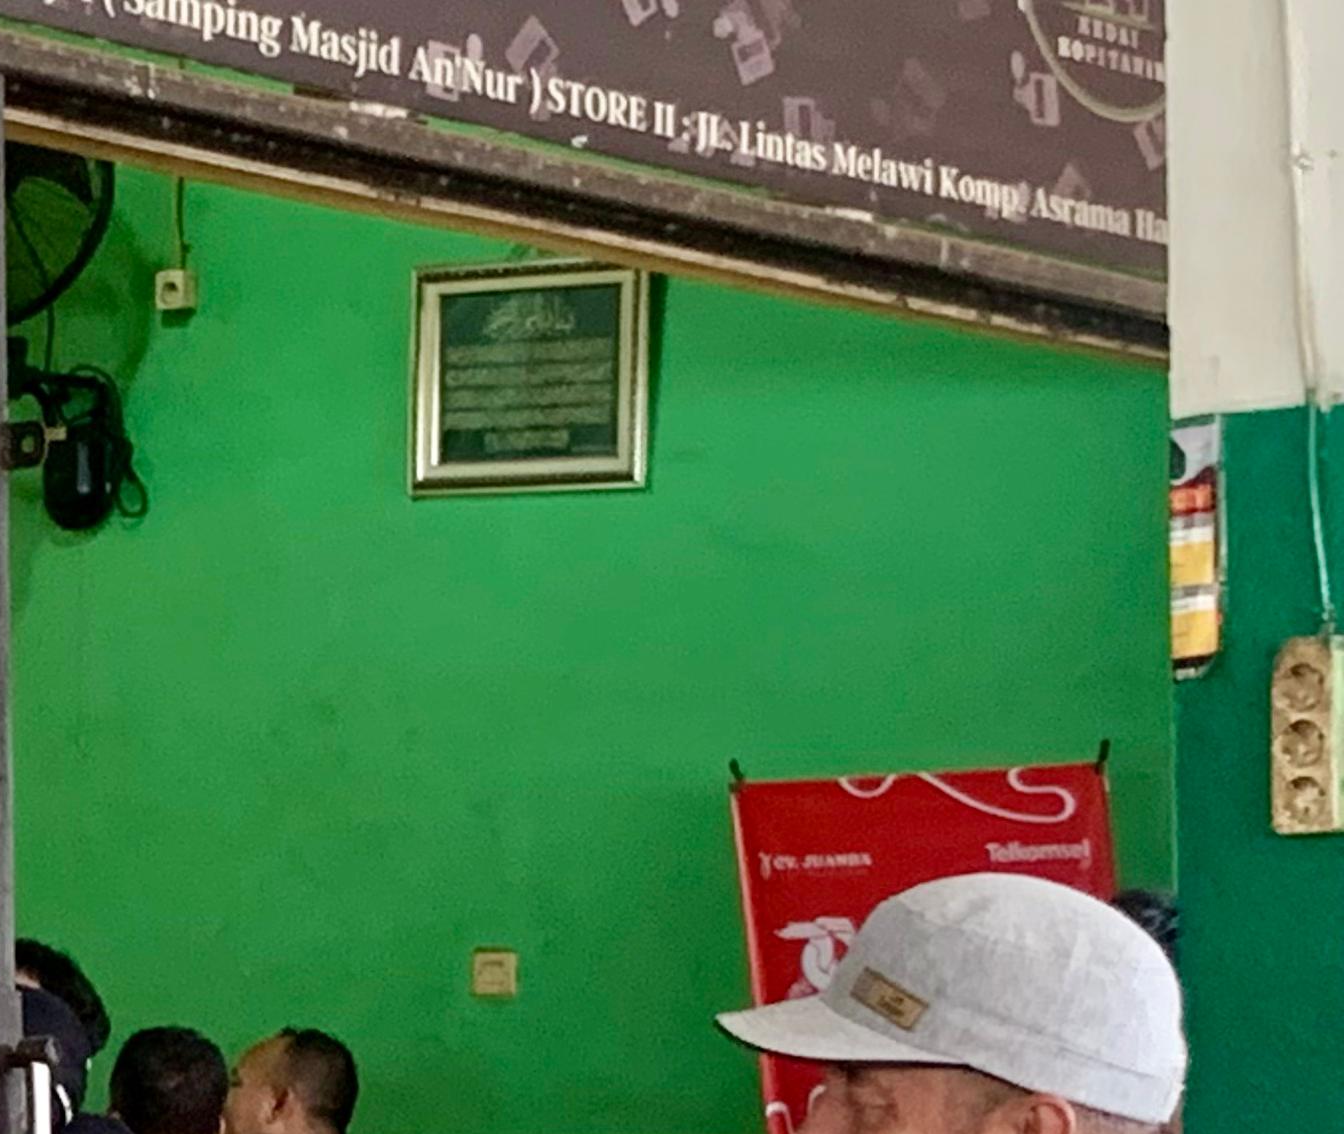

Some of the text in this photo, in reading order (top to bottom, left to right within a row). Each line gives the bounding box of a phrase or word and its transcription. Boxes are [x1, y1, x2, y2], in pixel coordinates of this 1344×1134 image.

[290, 15, 400, 78] Masjid
[547, 77, 648, 132] STORE
[653, 101, 676, 138] II
[738, 119, 828, 171] Lintas
[831, 142, 934, 195] Melawi
[1029, 187, 1131, 237] Asrama
